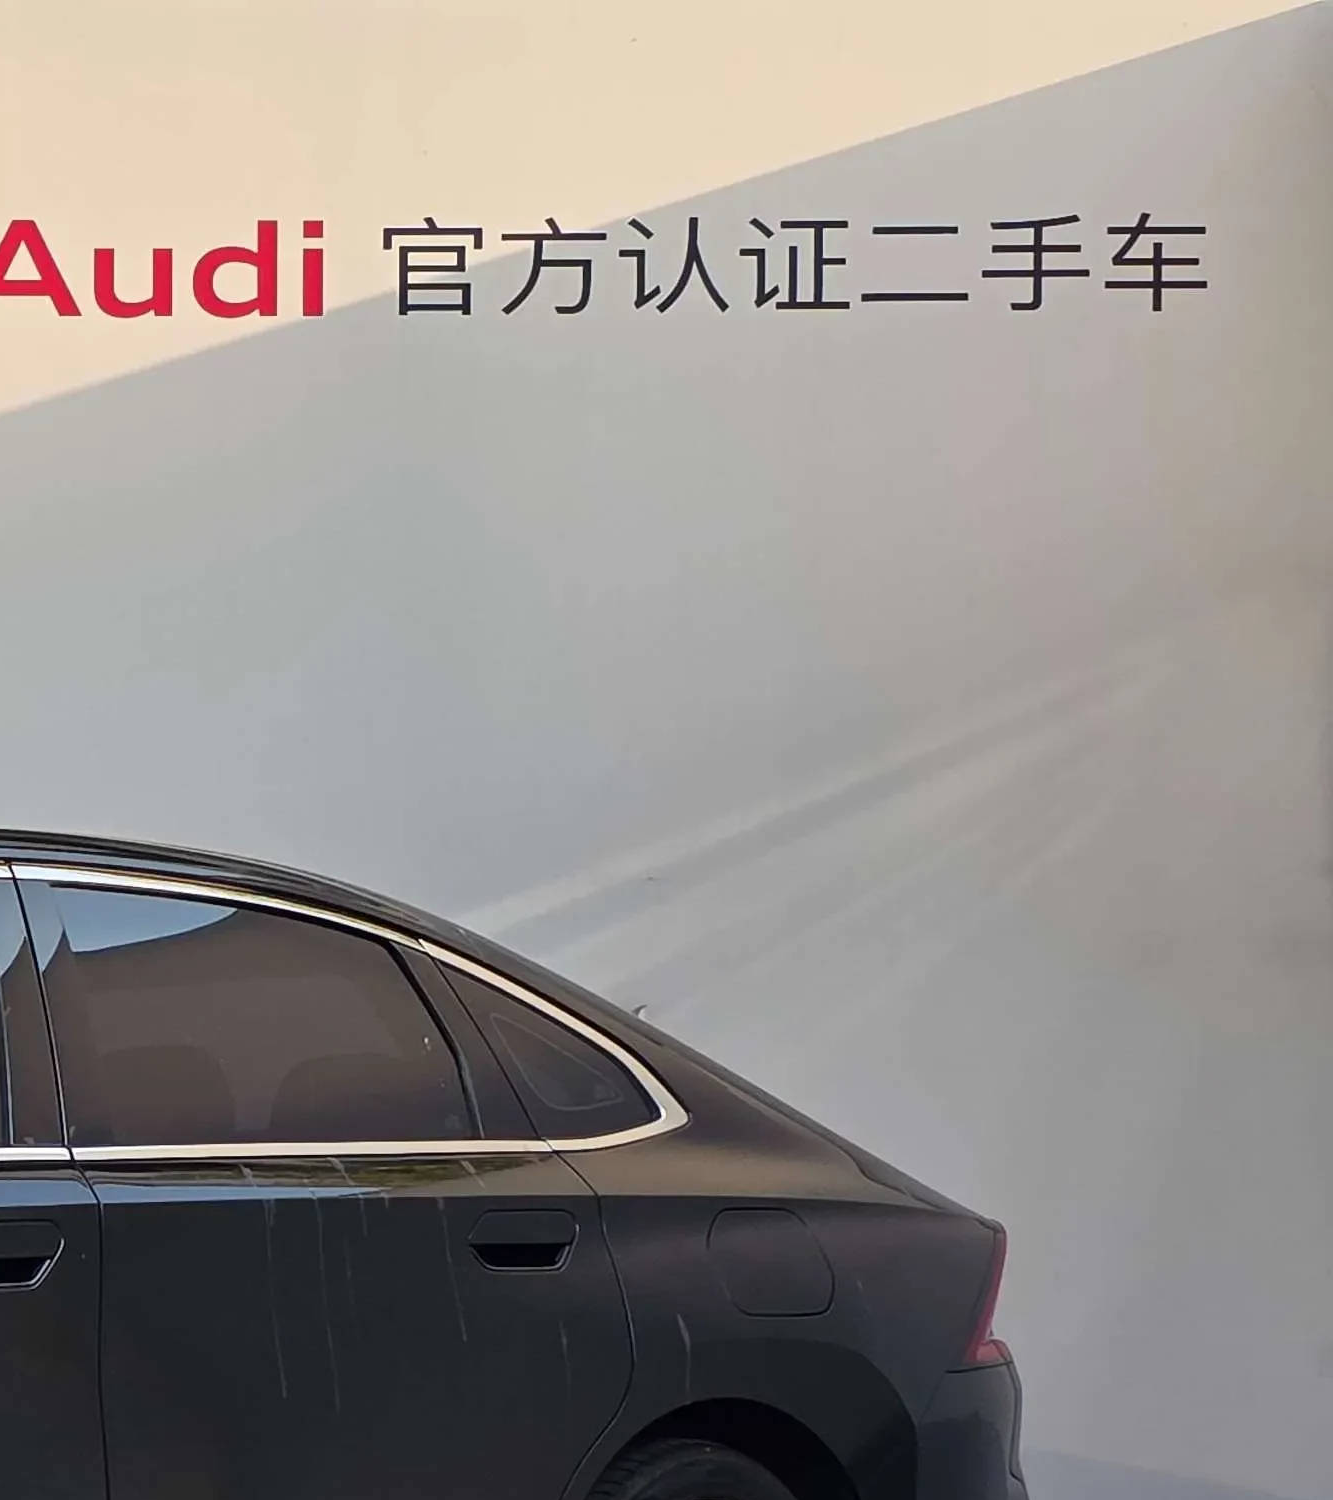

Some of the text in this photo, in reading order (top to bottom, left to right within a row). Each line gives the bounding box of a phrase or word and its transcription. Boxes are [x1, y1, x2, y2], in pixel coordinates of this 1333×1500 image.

[381, 213, 1210, 317] 官方认证二手车
